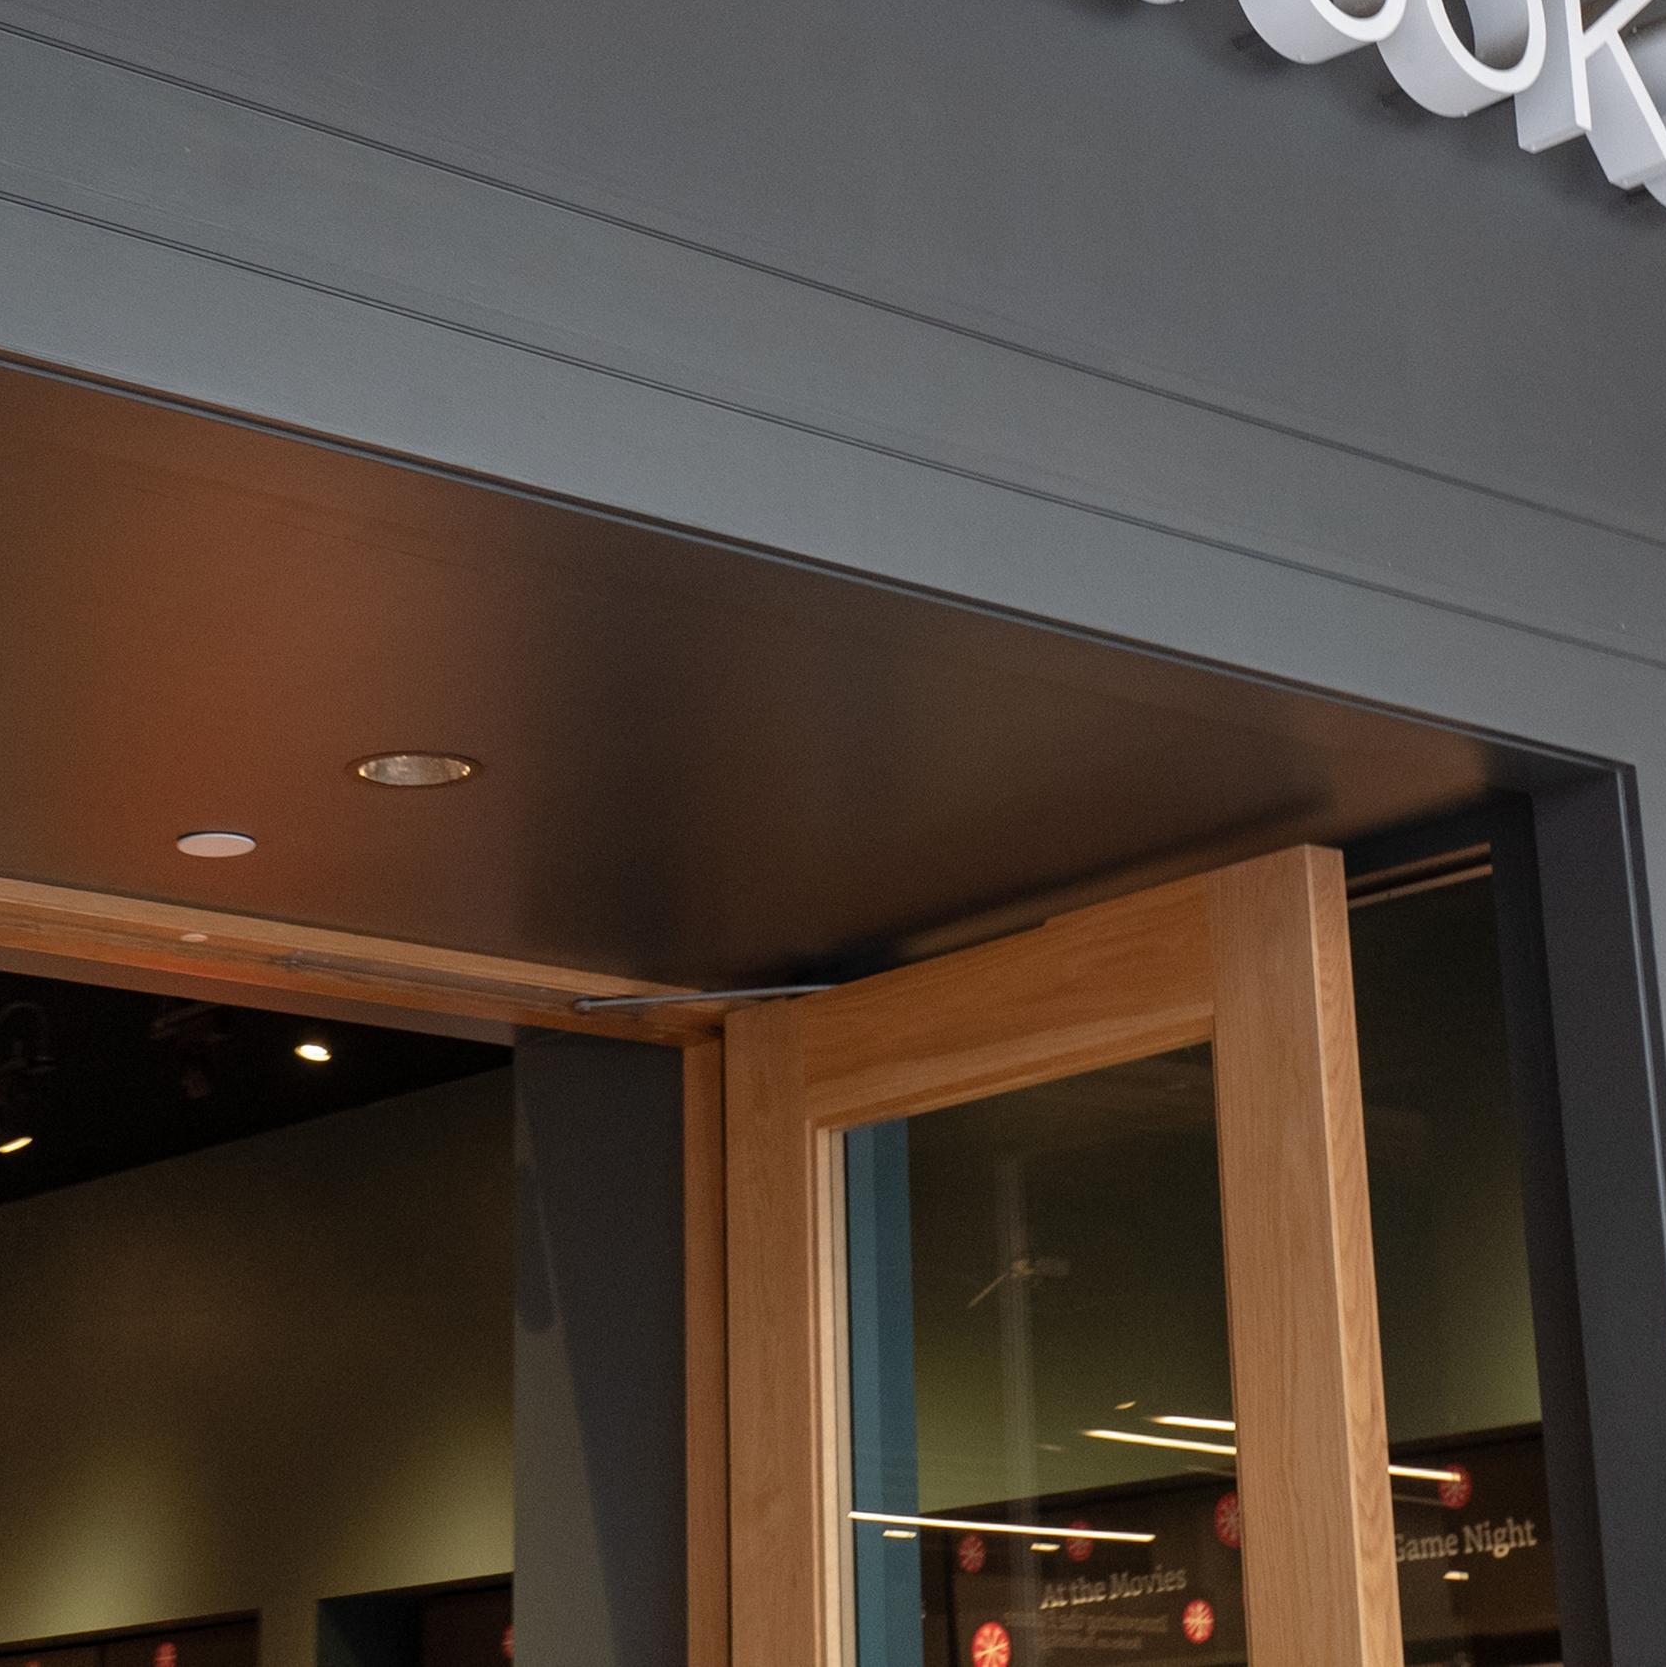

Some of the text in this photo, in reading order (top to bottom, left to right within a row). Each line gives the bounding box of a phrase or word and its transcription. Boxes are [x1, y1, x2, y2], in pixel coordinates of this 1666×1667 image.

[1462, 1516, 1538, 1559] Night
[1039, 1564, 1188, 1610] At the Movies
